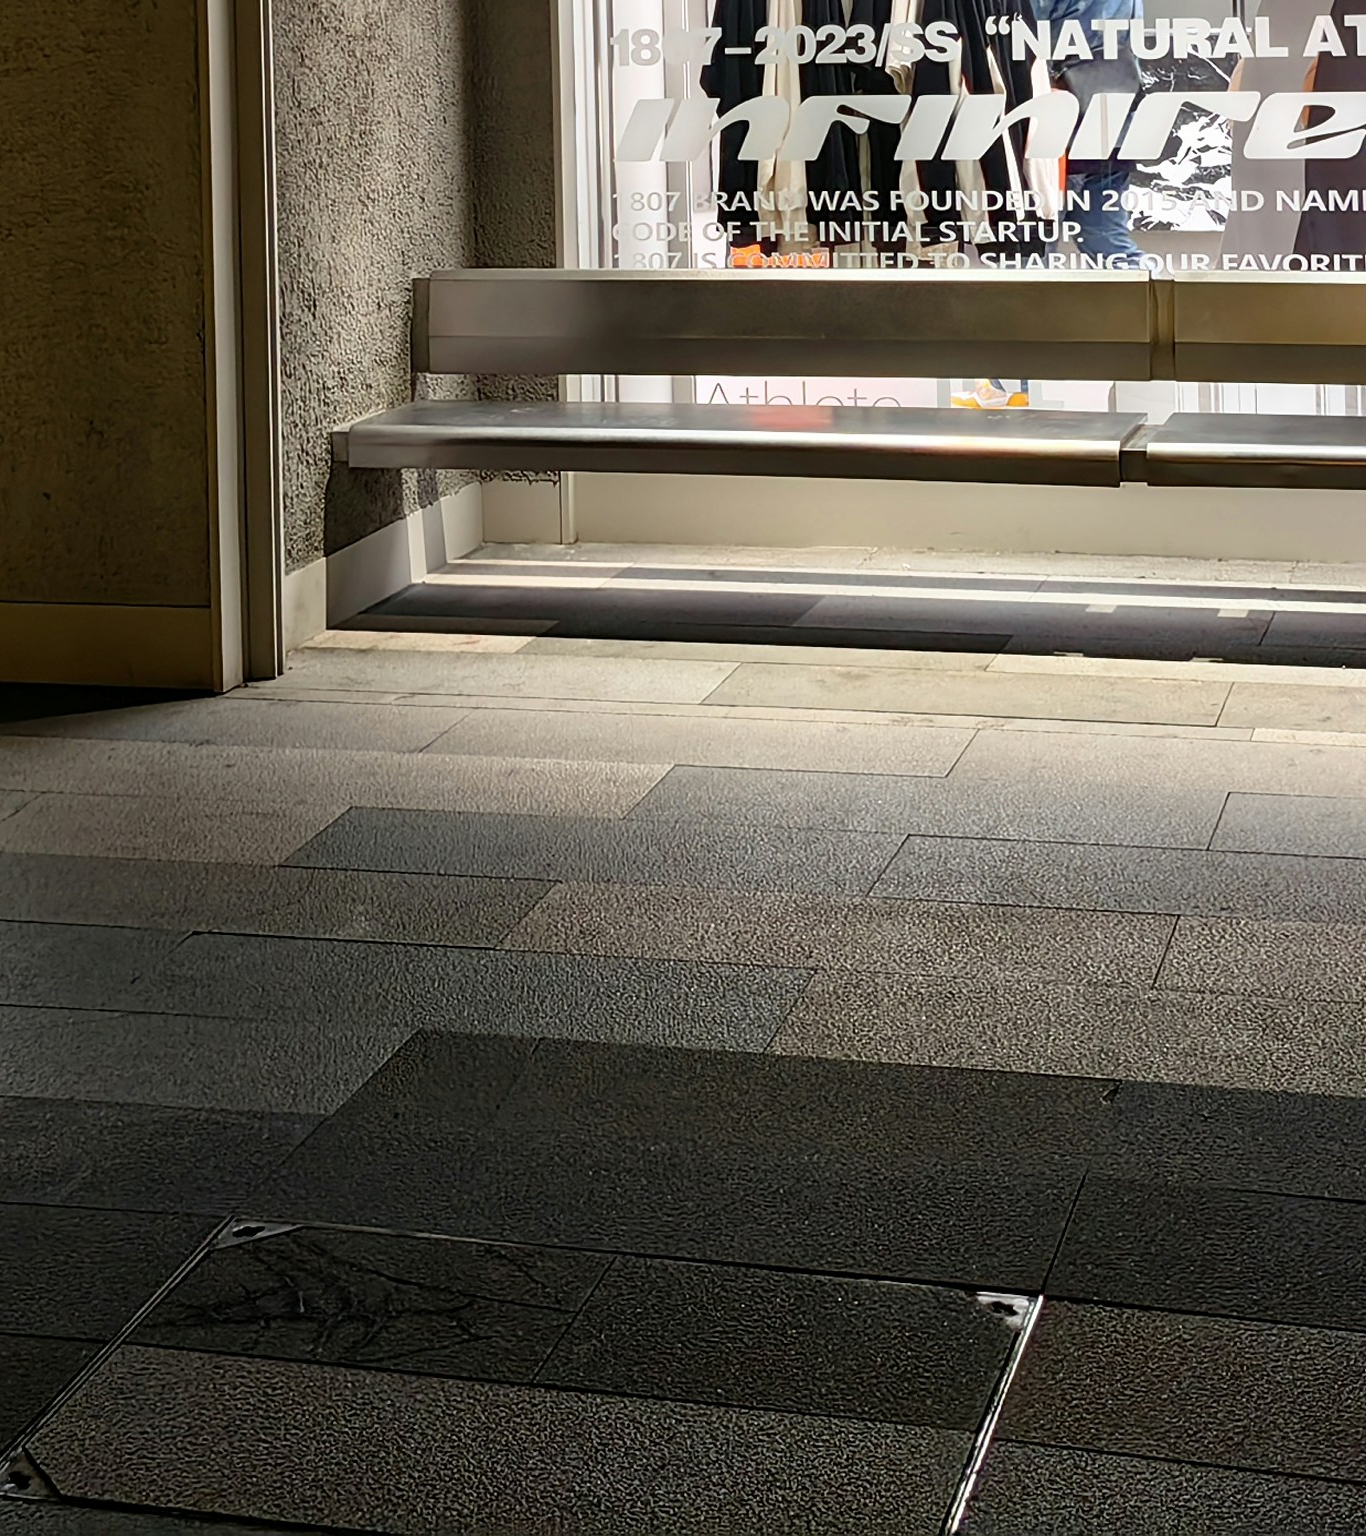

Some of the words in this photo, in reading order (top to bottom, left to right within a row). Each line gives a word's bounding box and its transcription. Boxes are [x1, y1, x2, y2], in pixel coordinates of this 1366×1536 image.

[611, 20, 961, 67] 187-2023/SS
[613, 191, 681, 212] 807
[810, 191, 880, 212] WAS
[890, 191, 1045, 212] FOUNDED
[1056, 190, 1091, 212] IN
[1101, 190, 1178, 212] 2015
[1190, 190, 1264, 212] AND
[702, 221, 742, 242] OF
[750, 221, 810, 242] THE
[819, 221, 931, 242] INITIAL
[939, 220, 1084, 243] STARTUP.
[614, 252, 682, 269] 807
[980, 252, 1130, 270] SHARING
